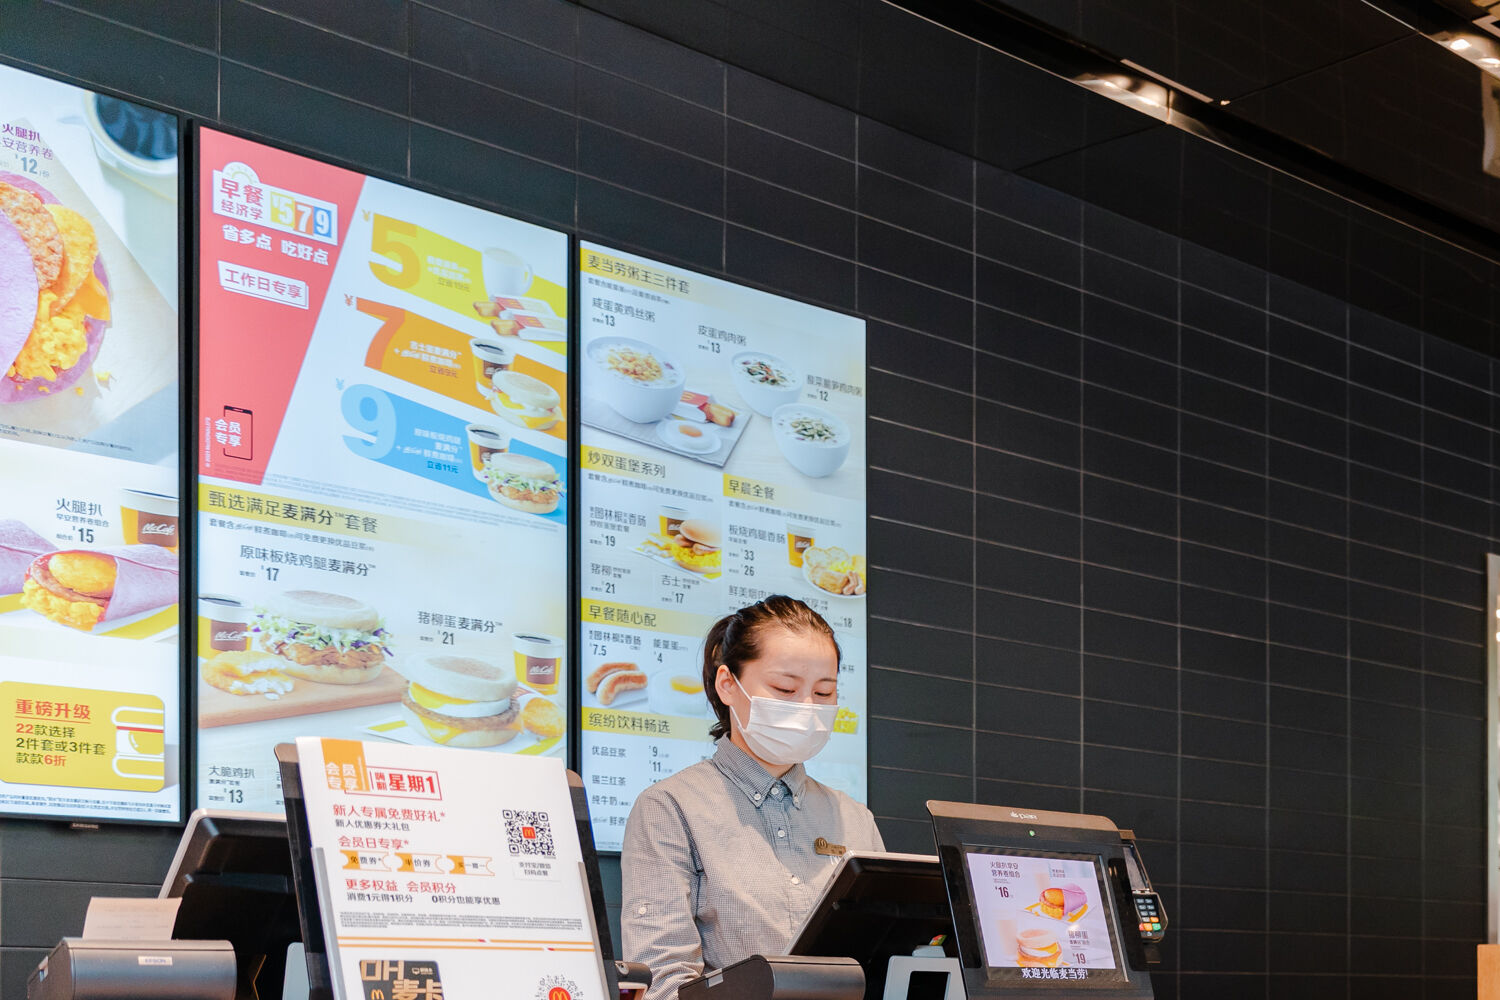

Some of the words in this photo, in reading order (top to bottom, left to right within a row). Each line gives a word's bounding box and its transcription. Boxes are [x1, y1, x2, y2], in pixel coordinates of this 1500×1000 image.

[220, 178, 264, 207] 早餐
[221, 199, 263, 220] 经济学
[222, 224, 272, 251] 省多点
[281, 240, 329, 266] 吃好点
[225, 268, 302, 298] 工作日专享
[588, 254, 690, 294] 麦当劳粥王三件套
[588, 450, 666, 479] 炒双蛋堡系列
[56, 497, 102, 516] 火腿扒
[589, 604, 657, 627] 早餐随心配
[16, 698, 91, 720] 重磅升级
[16, 723, 75, 739] 22款选择
[588, 712, 672, 734] 缤纷饮料畅选
[16, 737, 106, 756] 2件套或3件套
[16, 752, 67, 767] 款款6折
[326, 761, 357, 777] 会员
[388, 772, 435, 794] 星期1
[346, 878, 398, 892] 更多权益
[406, 881, 456, 894] 会员积分
[1021, 968, 1089, 981] 欢迎光临麦当劳!
